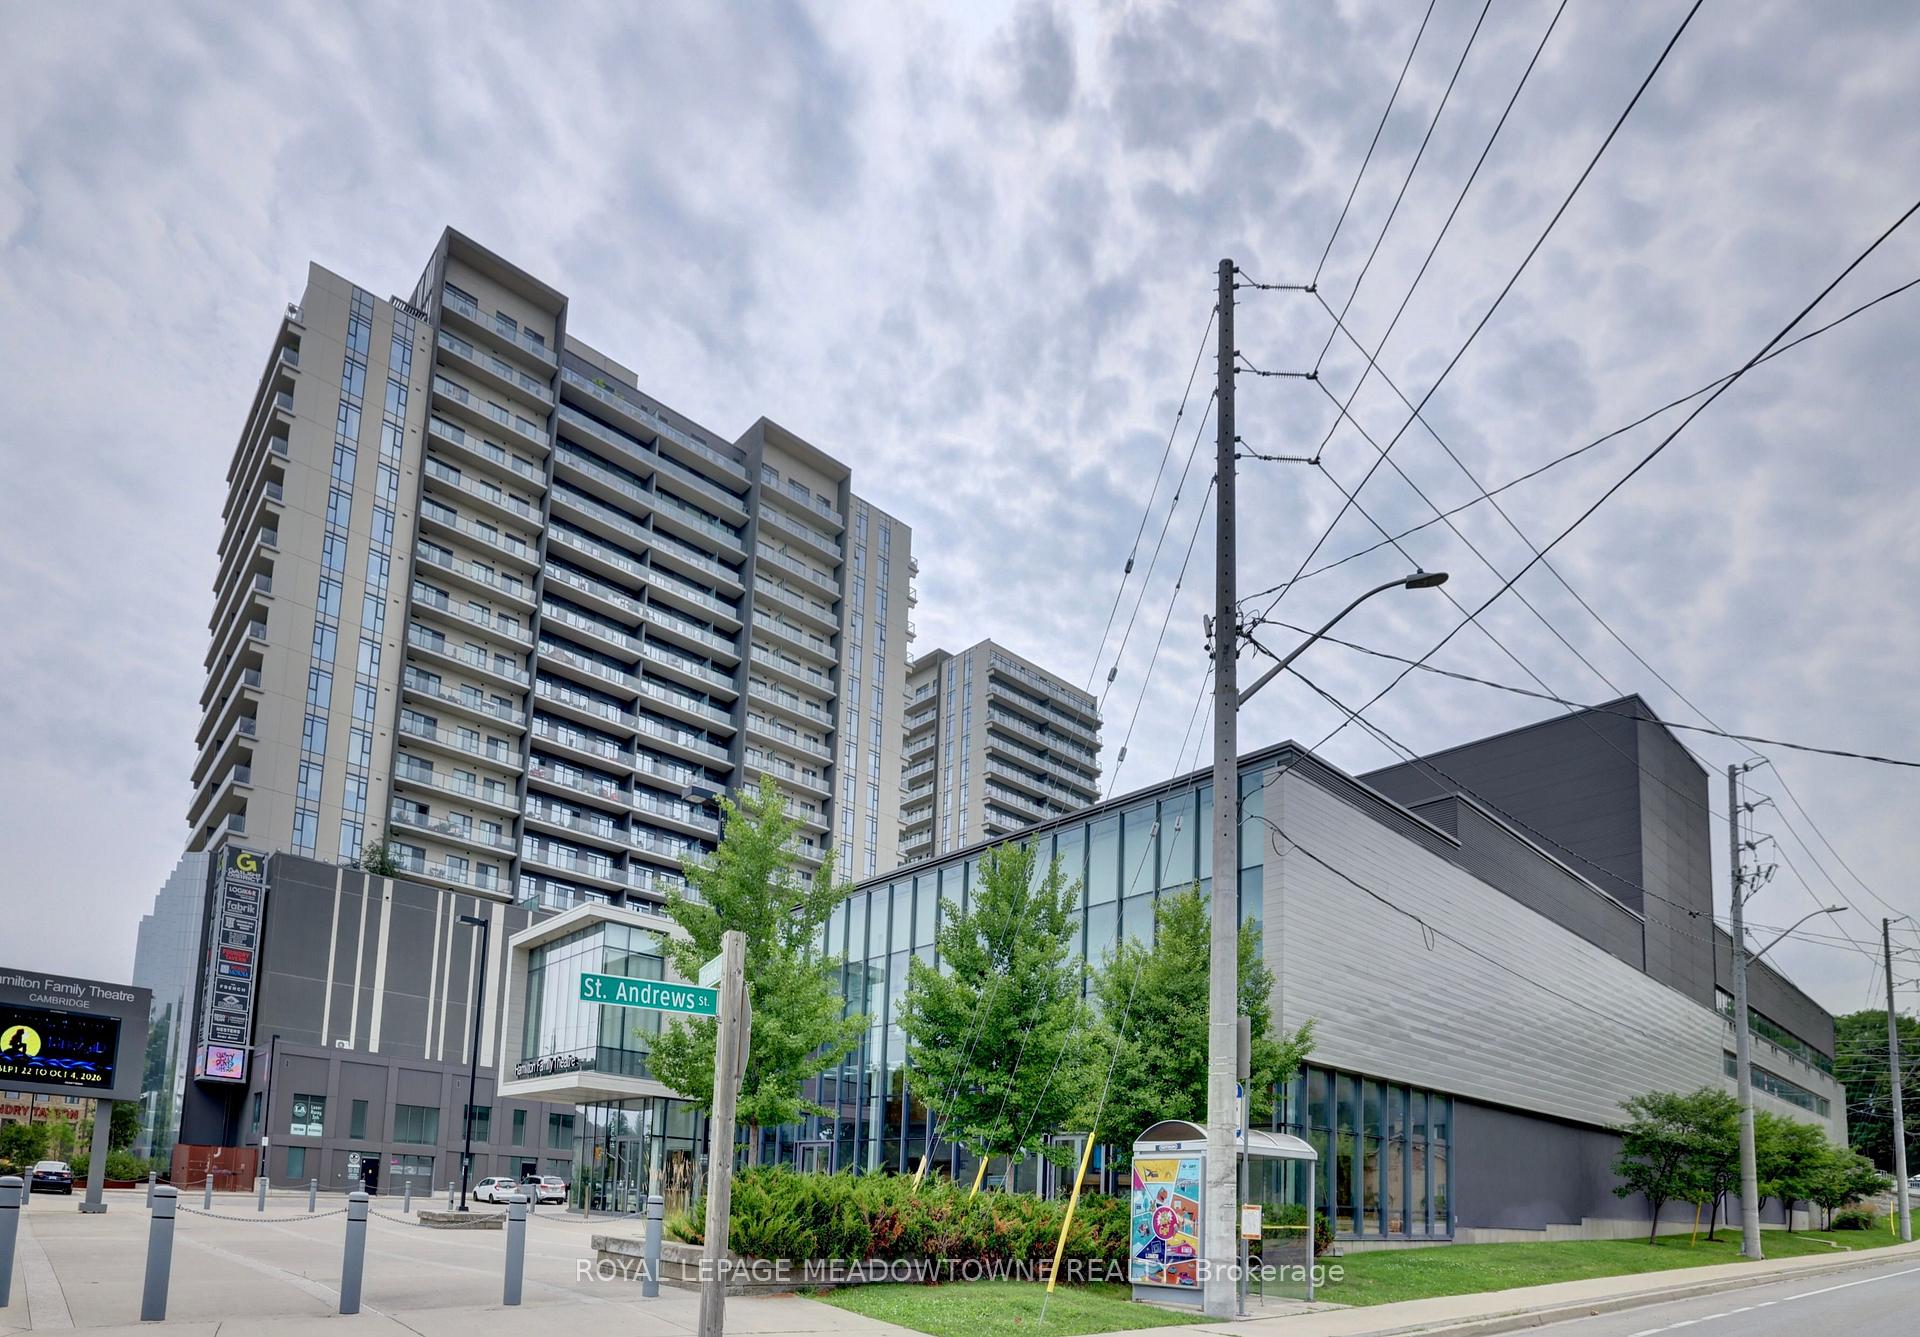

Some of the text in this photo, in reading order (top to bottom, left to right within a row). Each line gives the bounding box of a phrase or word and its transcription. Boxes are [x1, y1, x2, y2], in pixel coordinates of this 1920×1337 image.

[227, 901, 256, 914] fabrik
[44, 980, 86, 998] Family
[89, 985, 135, 1003] Theatre
[584, 977, 710, 1010] St. Andrews St.
[29, 993, 90, 1009] CAMBRIDGE
[21, 1068, 32, 1076] 22
[35, 1069, 48, 1077] TO
[50, 1070, 67, 1079] OCT
[81, 1073, 102, 1082] 2026
